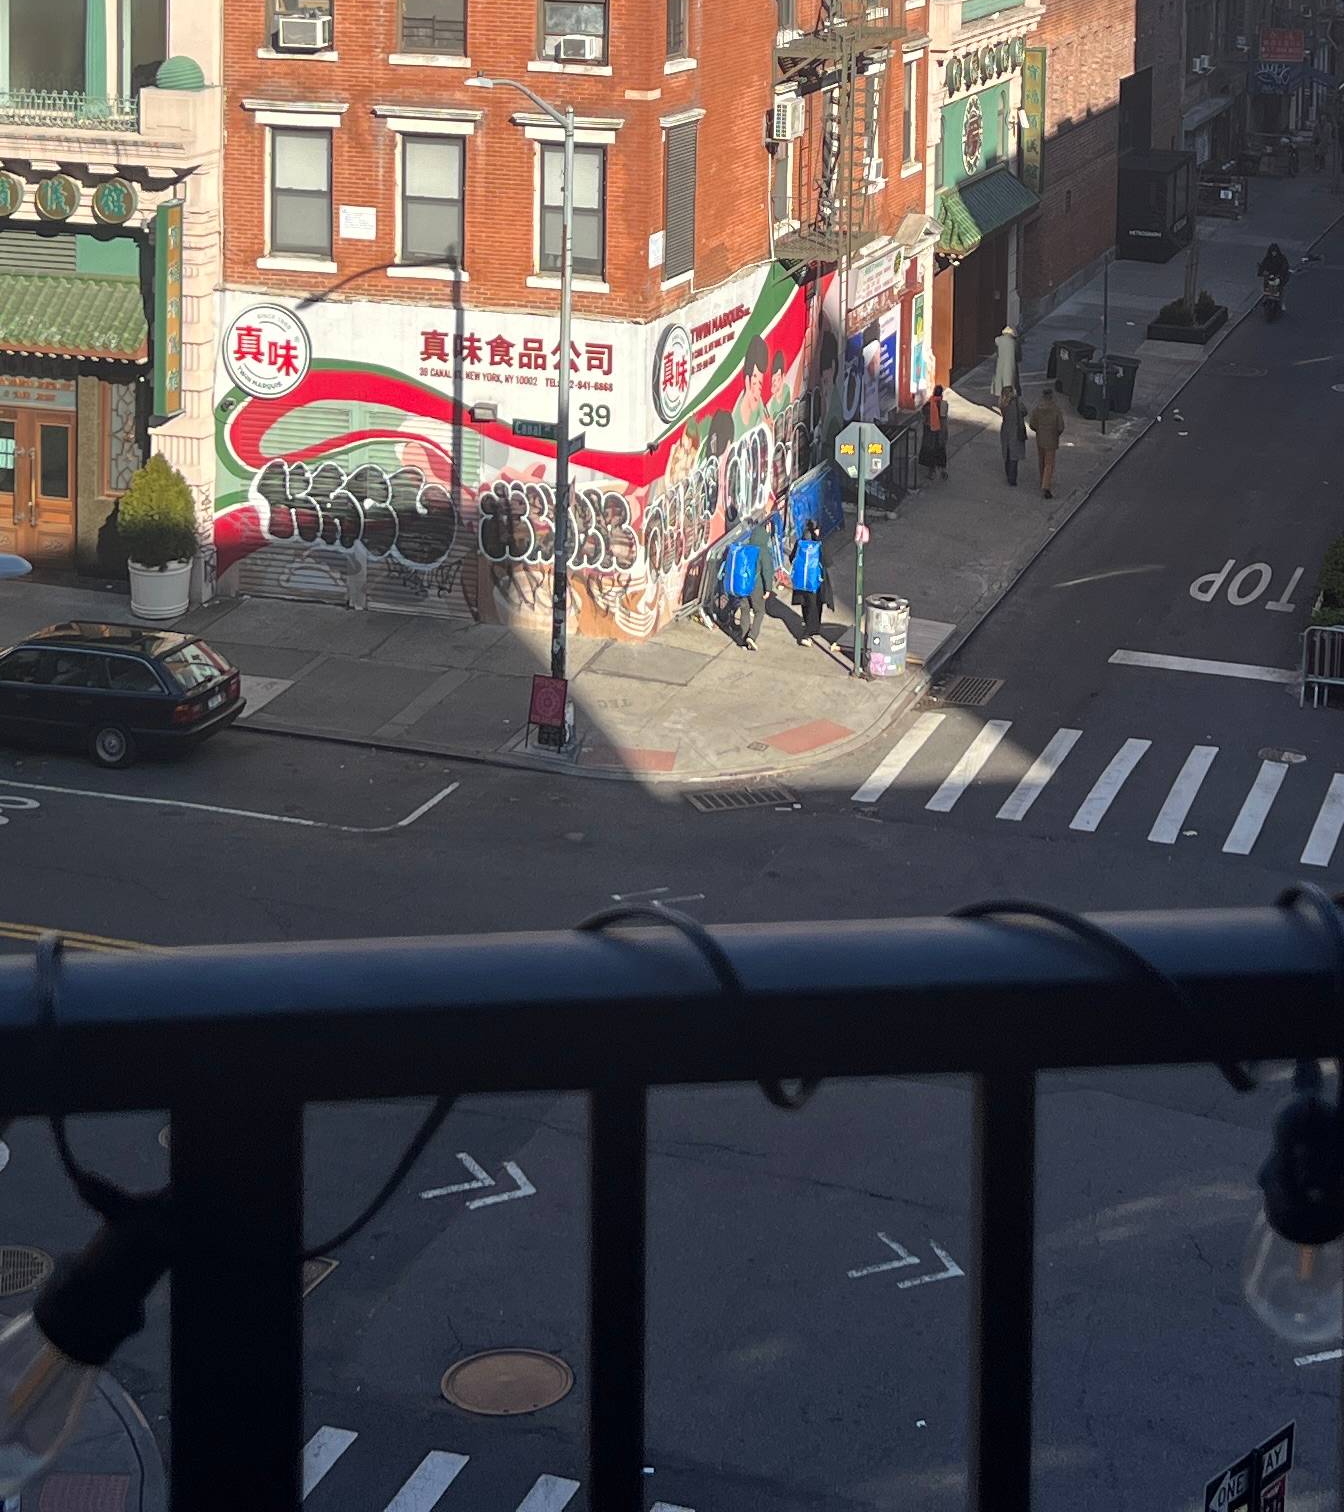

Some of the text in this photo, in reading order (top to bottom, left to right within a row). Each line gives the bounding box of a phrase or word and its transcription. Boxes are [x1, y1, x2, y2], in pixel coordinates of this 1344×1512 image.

[233, 325, 299, 377] 真味
[420, 330, 613, 376] 真味食品公司
[579, 402, 611, 428] 39
[1218, 1470, 1245, 1508] ONE
